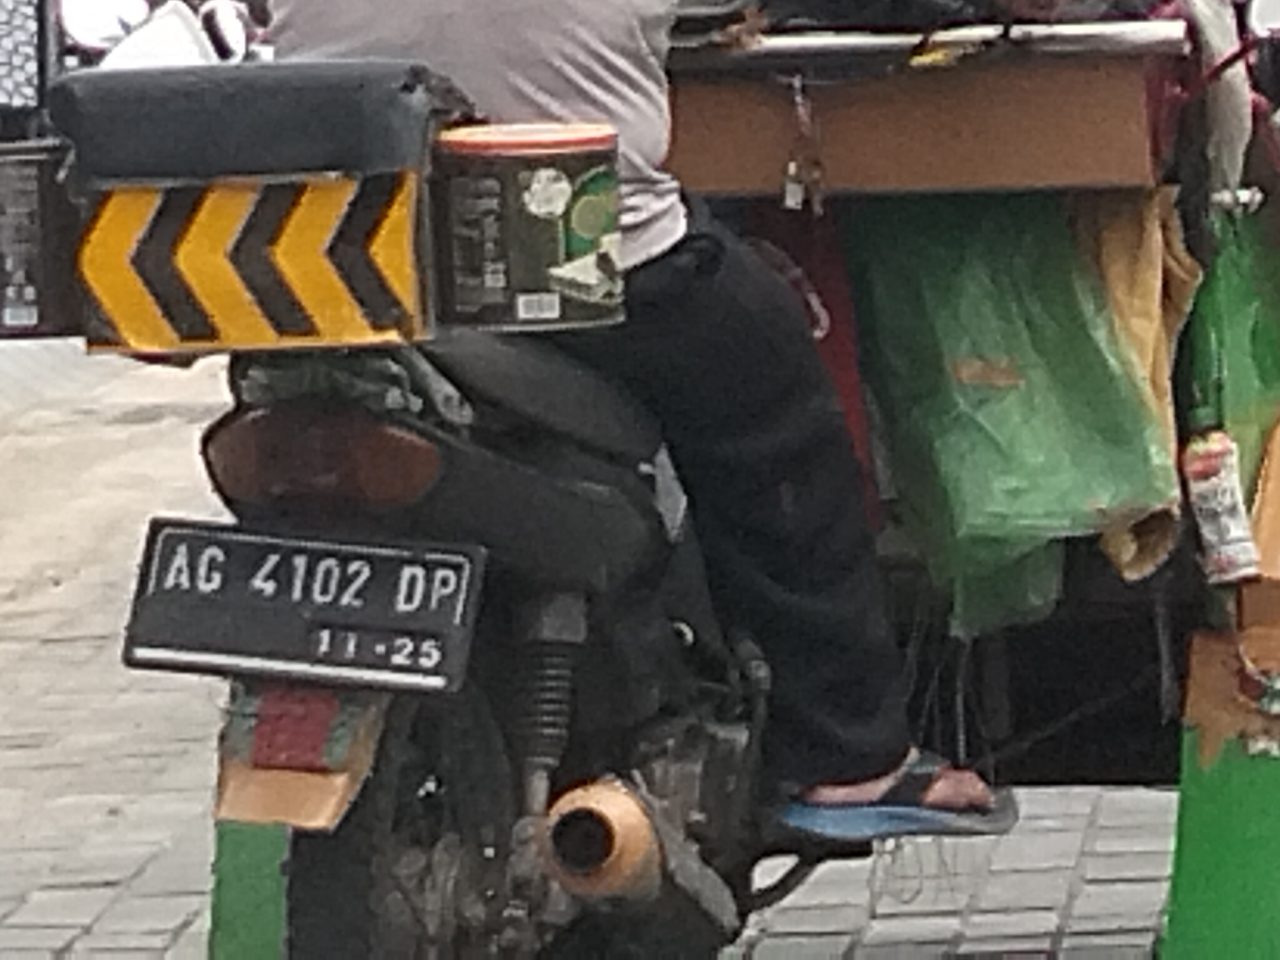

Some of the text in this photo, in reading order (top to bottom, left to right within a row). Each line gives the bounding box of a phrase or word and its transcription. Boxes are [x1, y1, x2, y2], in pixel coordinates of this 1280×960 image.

[163, 543, 458, 613] AG 4102 DP
